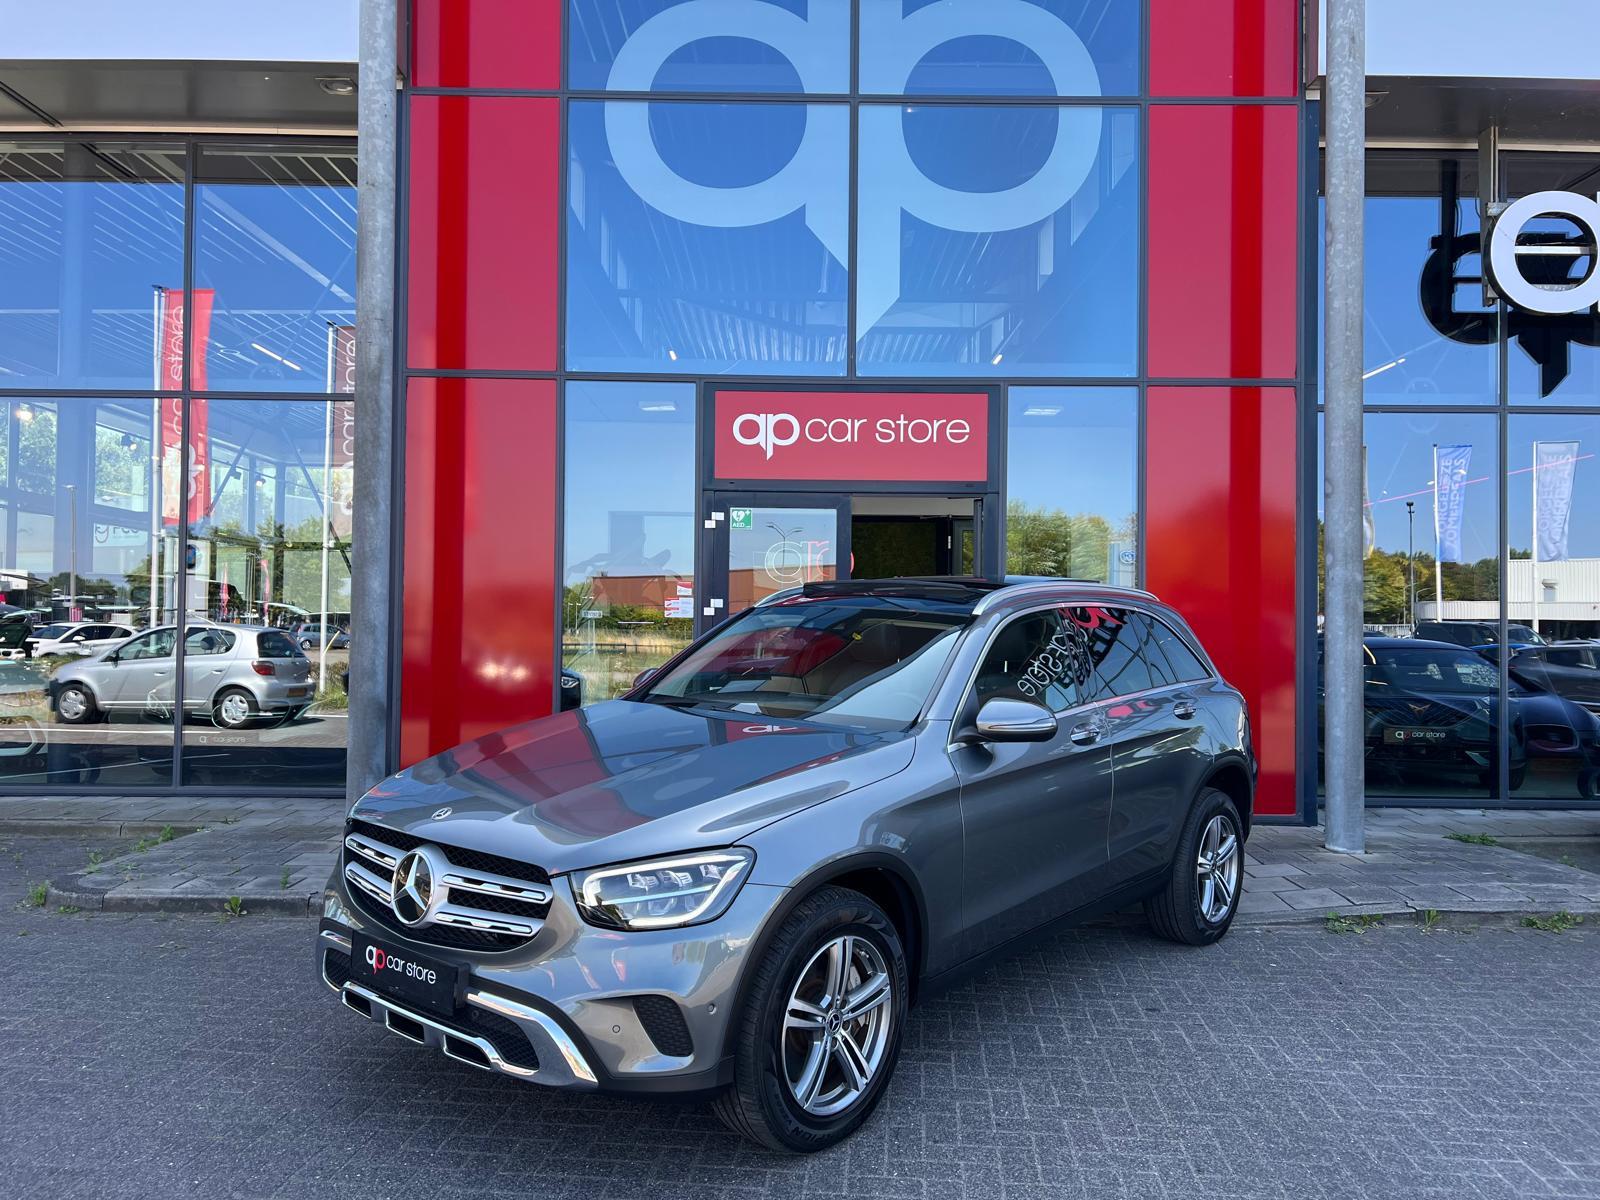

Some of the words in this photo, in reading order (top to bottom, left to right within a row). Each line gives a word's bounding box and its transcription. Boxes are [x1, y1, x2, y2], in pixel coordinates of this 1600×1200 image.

[732, 413, 800, 461] ap
[804, 417, 868, 443] car
[875, 414, 970, 444] store
[365, 945, 386, 975] ap
[386, 955, 405, 973] car
[405, 962, 437, 984] store
